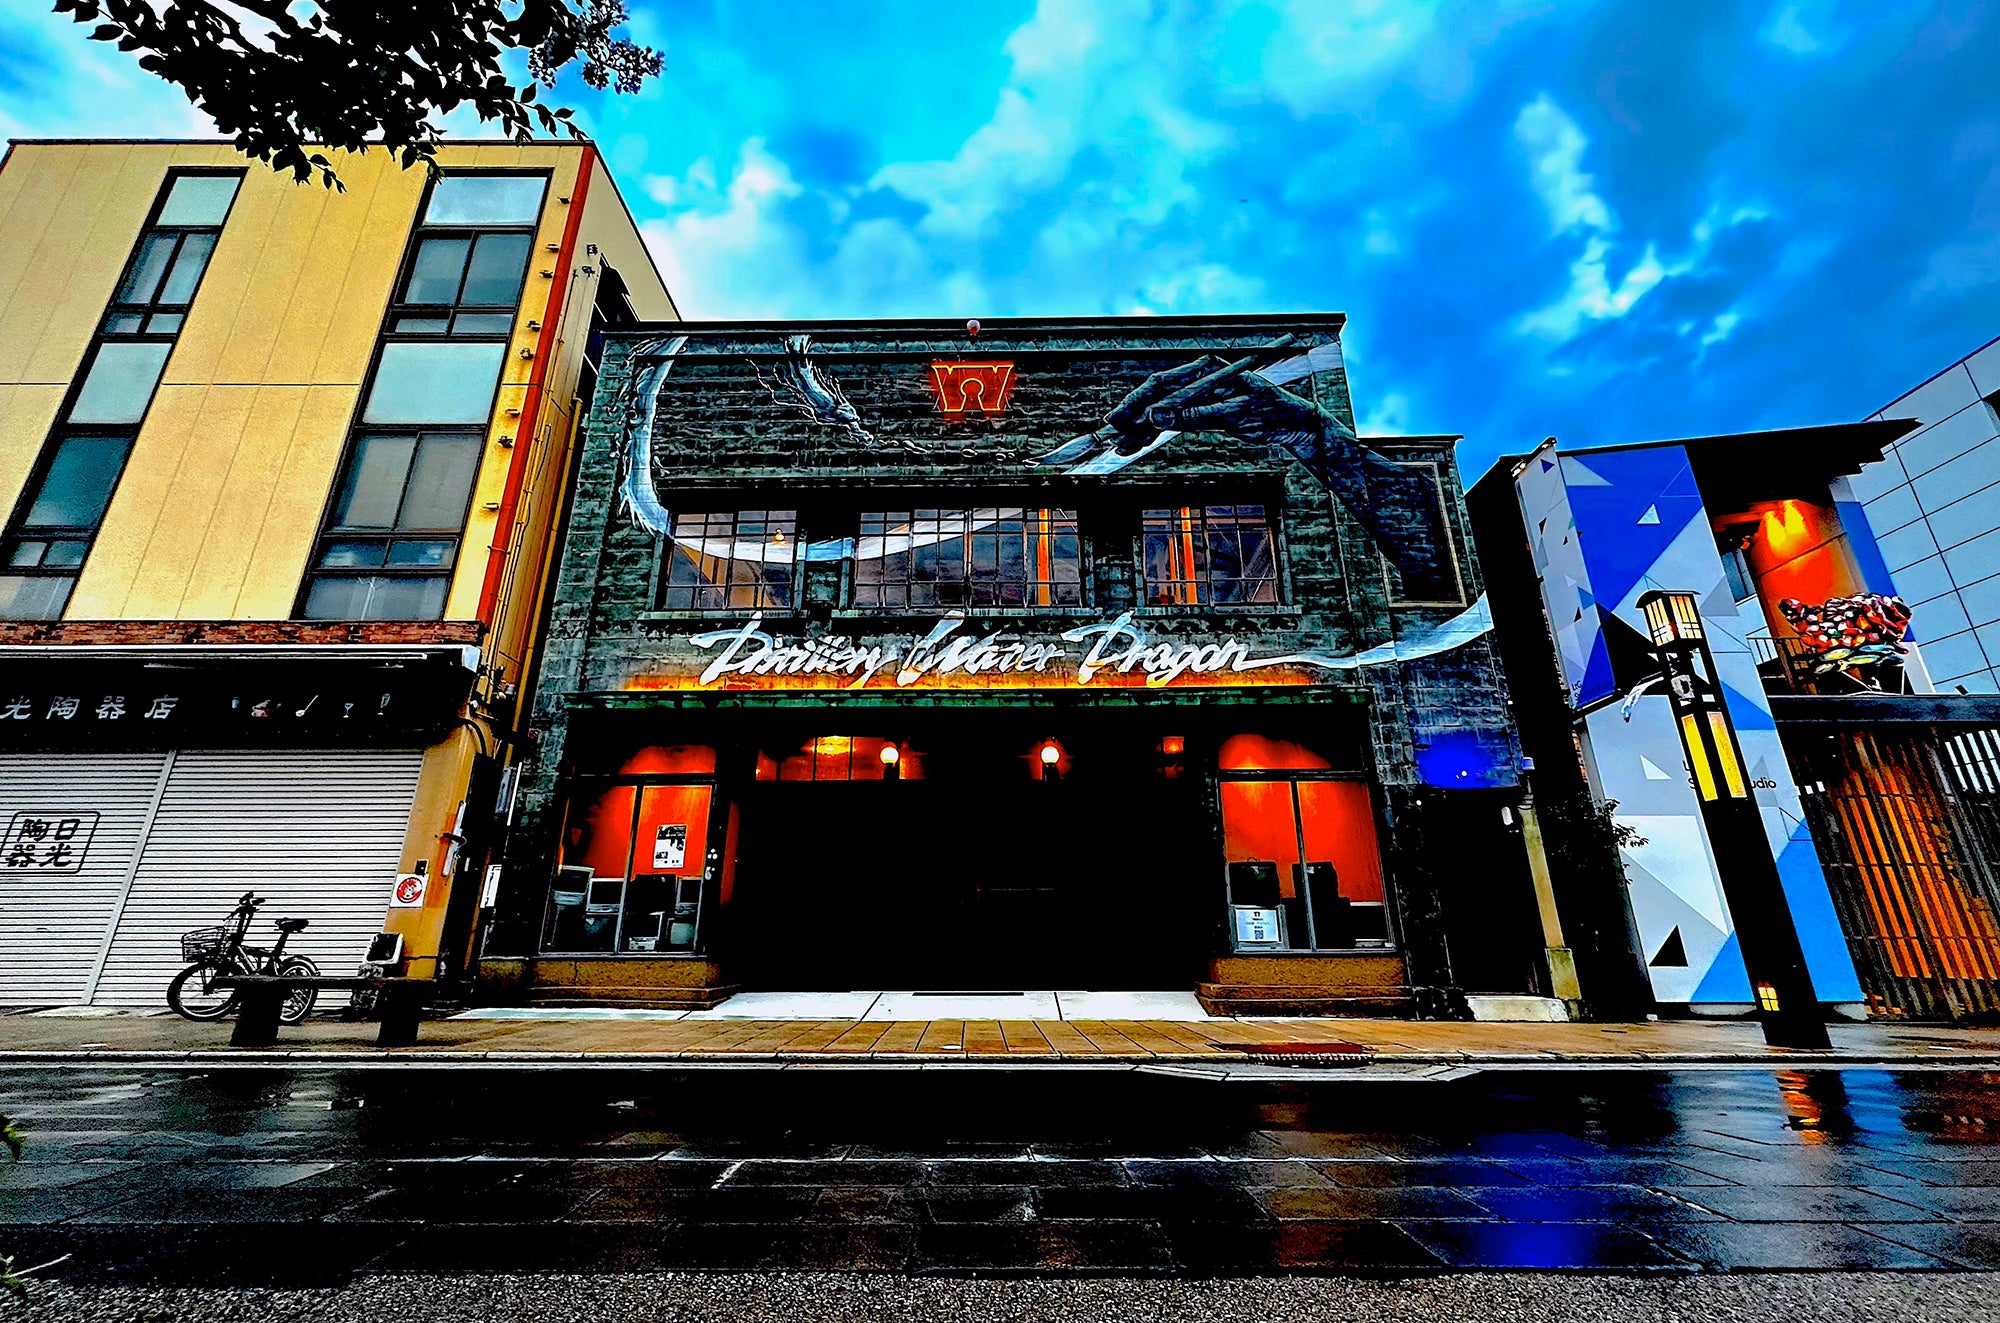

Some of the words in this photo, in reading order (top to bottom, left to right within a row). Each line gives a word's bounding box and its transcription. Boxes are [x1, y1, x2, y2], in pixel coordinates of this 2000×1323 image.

[1060, 610, 1256, 687] Dragon
[0, 695, 179, 720] 光陶器店
